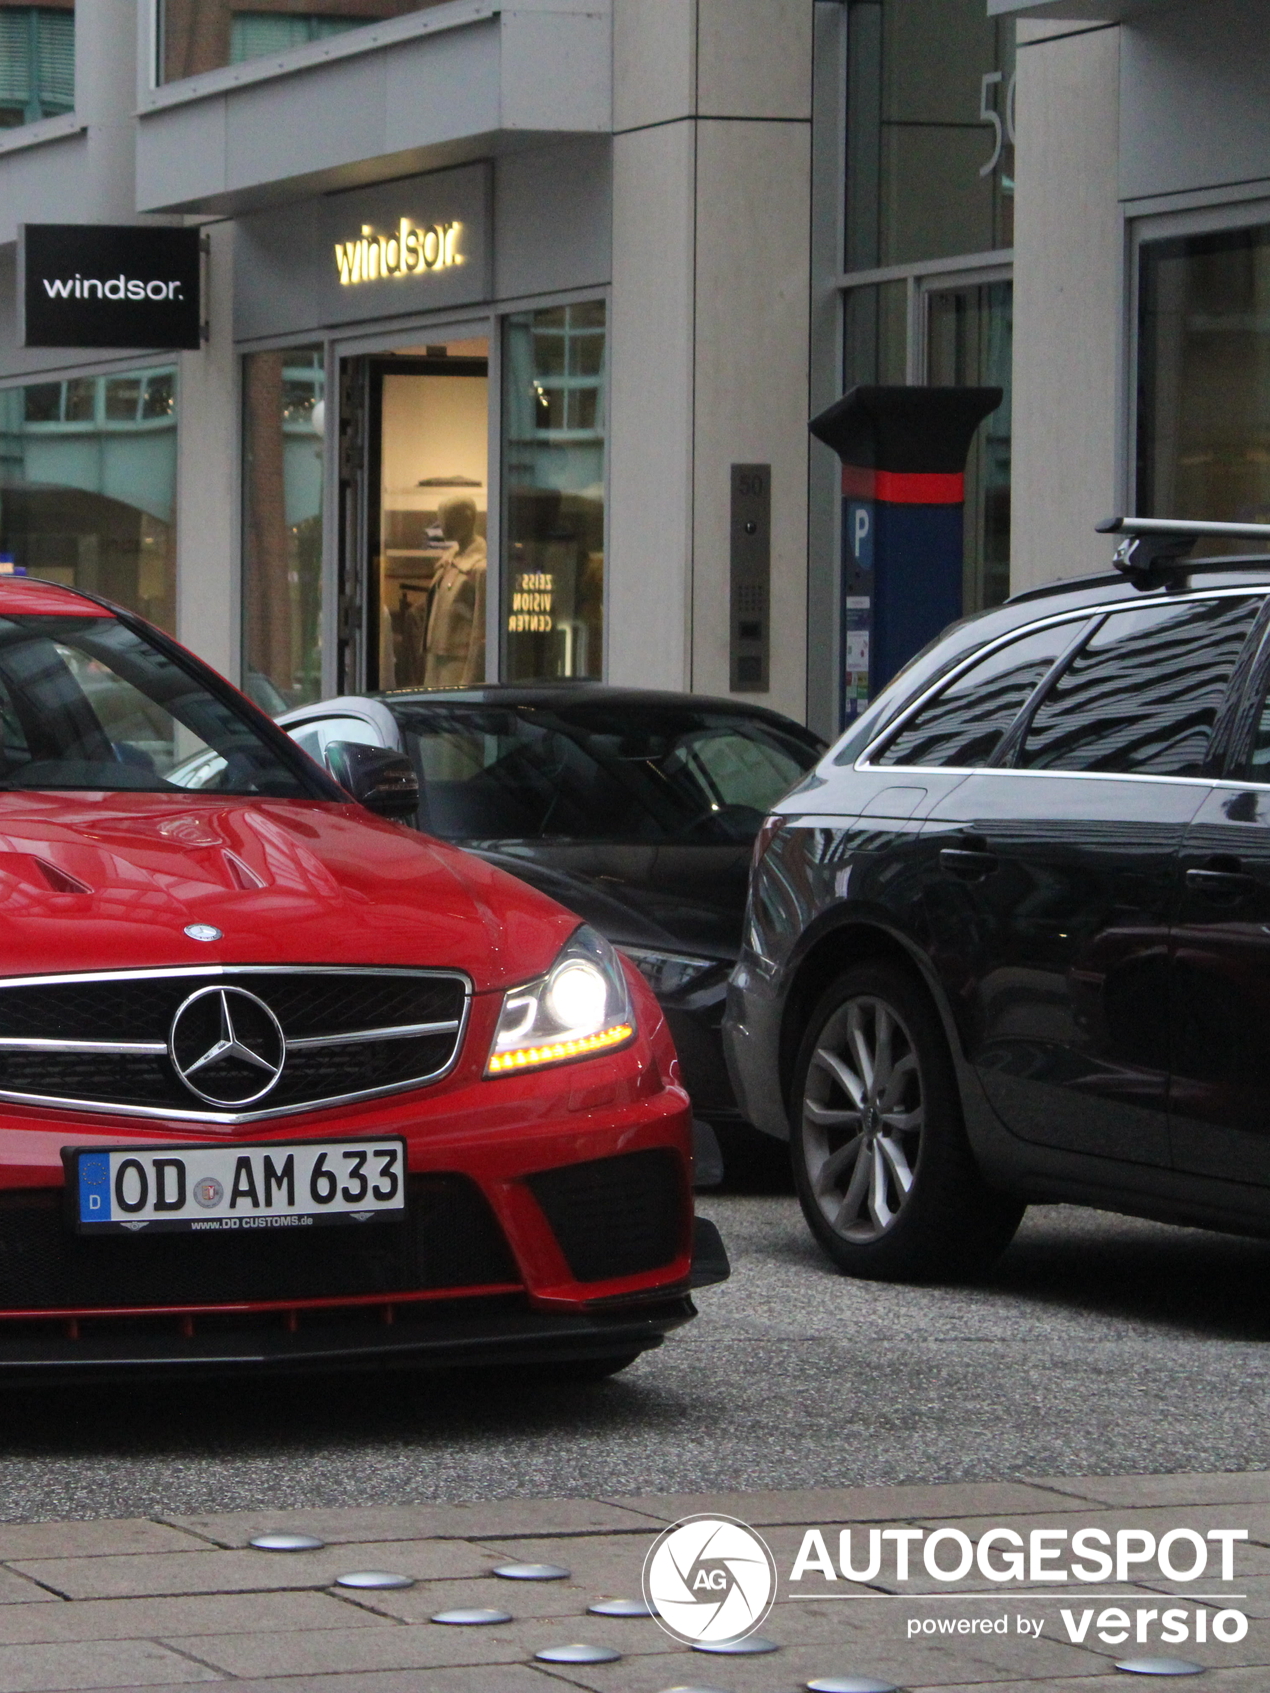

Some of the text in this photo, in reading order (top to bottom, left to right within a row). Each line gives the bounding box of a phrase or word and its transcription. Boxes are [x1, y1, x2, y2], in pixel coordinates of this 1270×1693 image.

[335, 217, 464, 285] windsor.
[43, 274, 185, 300] windsor.
[854, 508, 870, 557] P
[115, 1149, 399, 1212] OD AM 633
[89, 1194, 101, 1210] D
[191, 1216, 313, 1230] www.DD CUSTOMS.de
